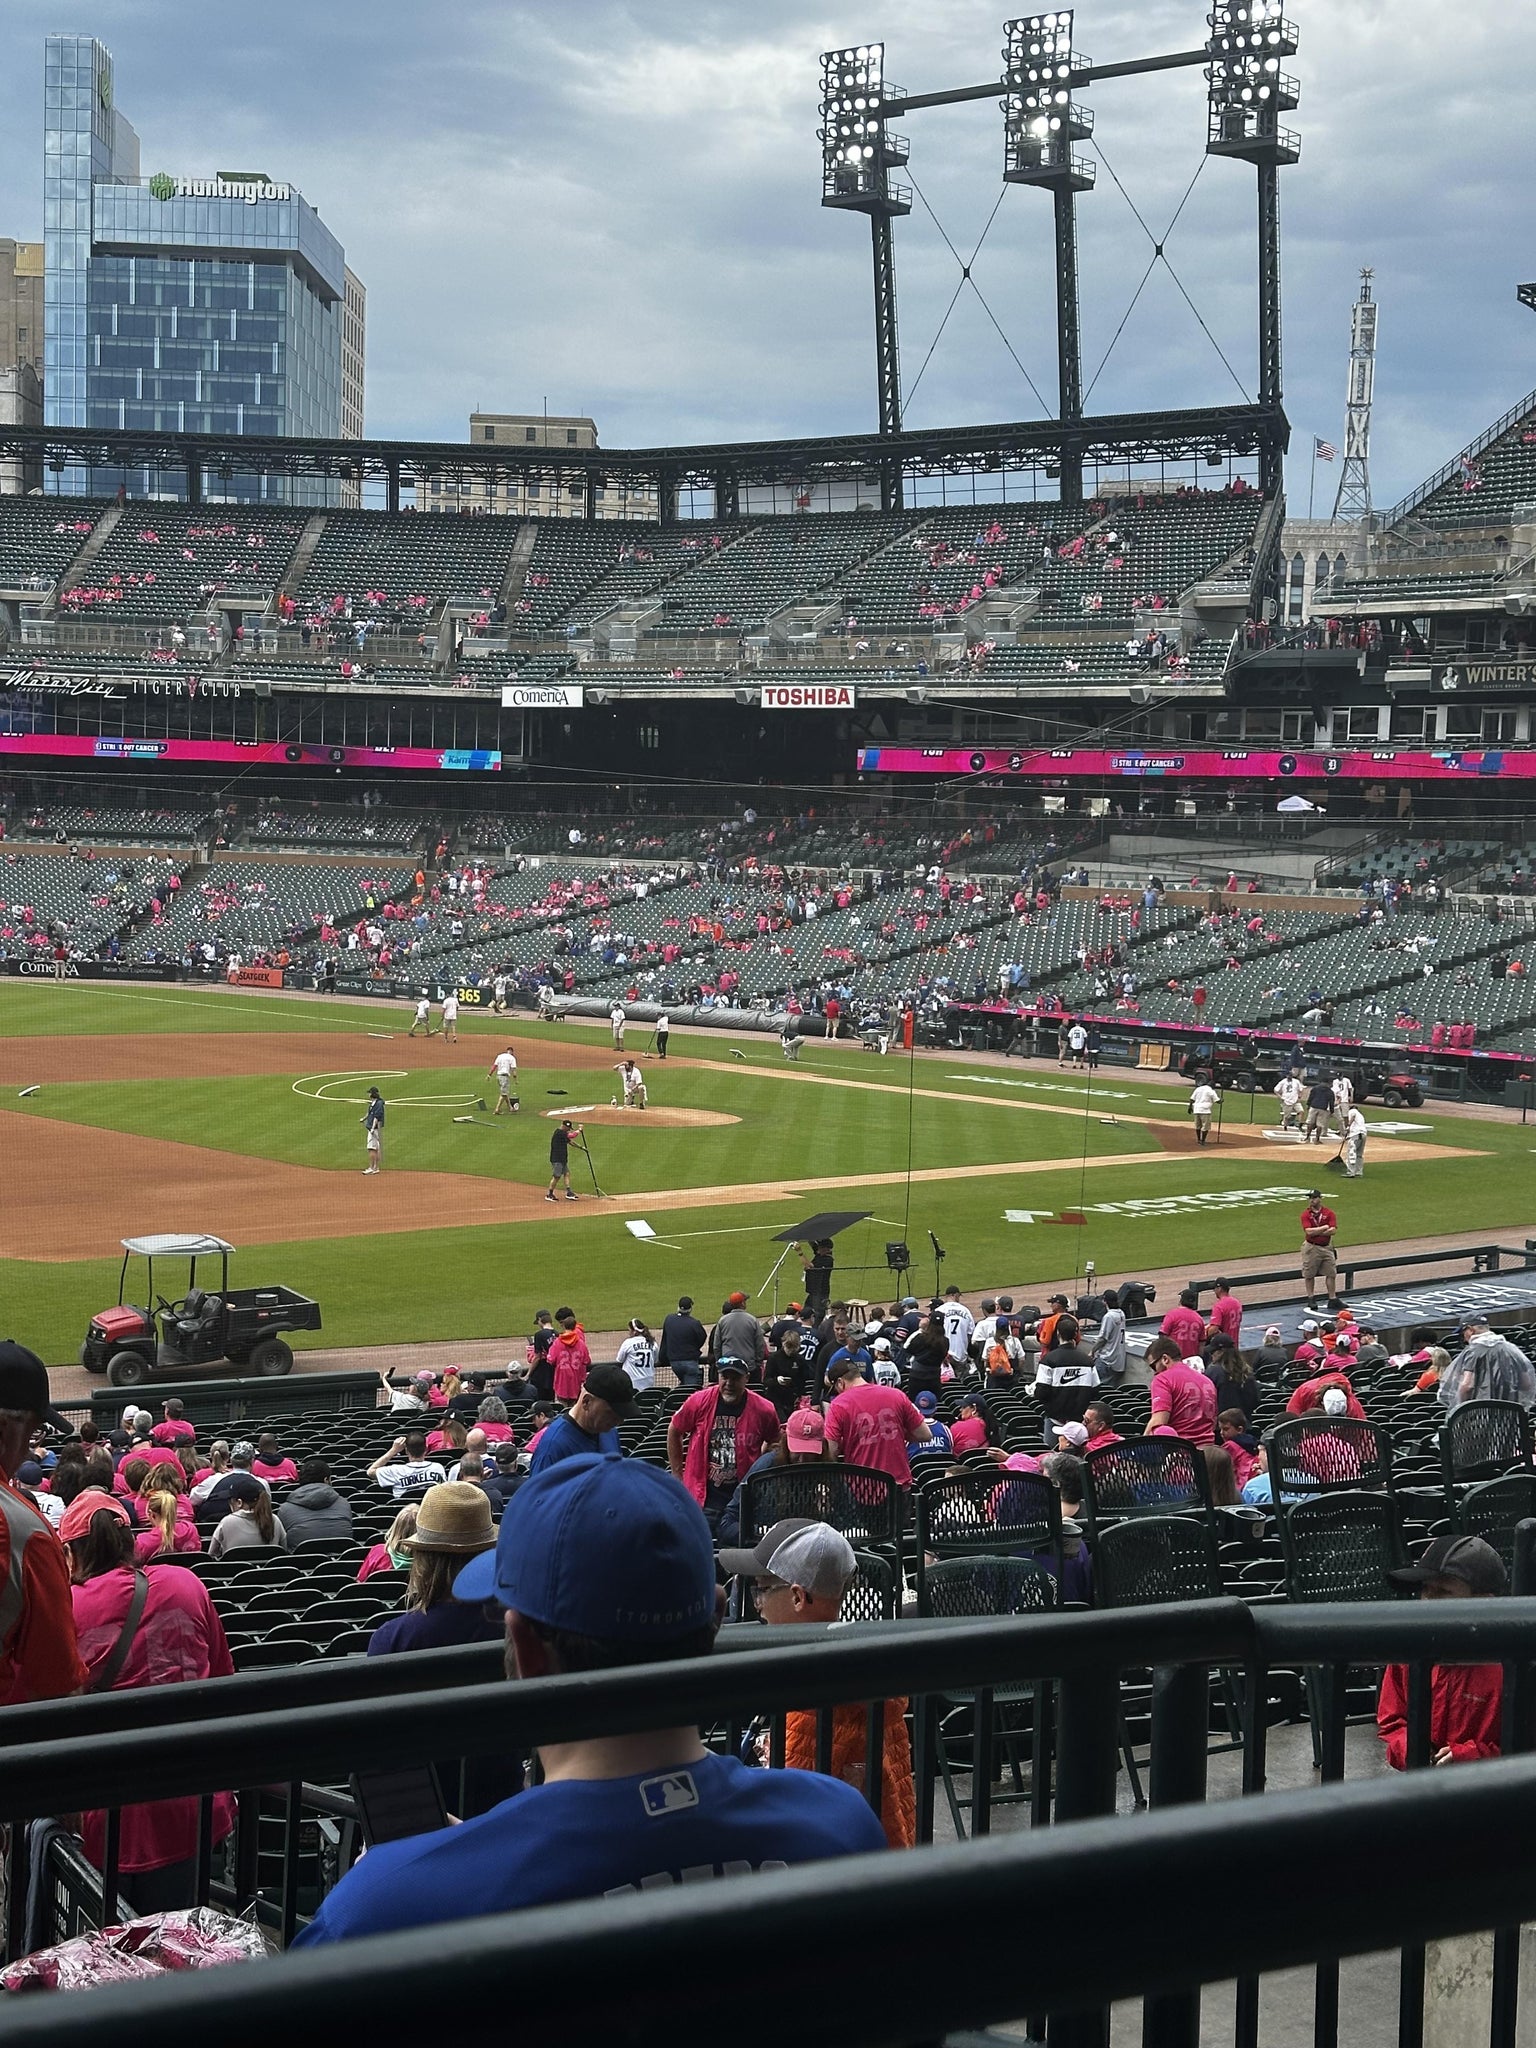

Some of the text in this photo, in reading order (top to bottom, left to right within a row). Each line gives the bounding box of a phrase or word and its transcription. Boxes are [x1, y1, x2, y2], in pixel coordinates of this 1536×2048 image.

[179, 175, 291, 205] Huntington
[132, 679, 242, 698] TIGER CLUB
[764, 688, 851, 706] TOSHIBA
[437, 986, 481, 1003] bt365
[1065, 1186, 1312, 1214] VICTORS
[950, 1319, 960, 1335] 7
[1177, 1320, 1201, 1342] 26
[634, 1351, 652, 1369] 31
[1063, 1367, 1082, 1378] NIKE
[855, 1407, 899, 1447] 26
